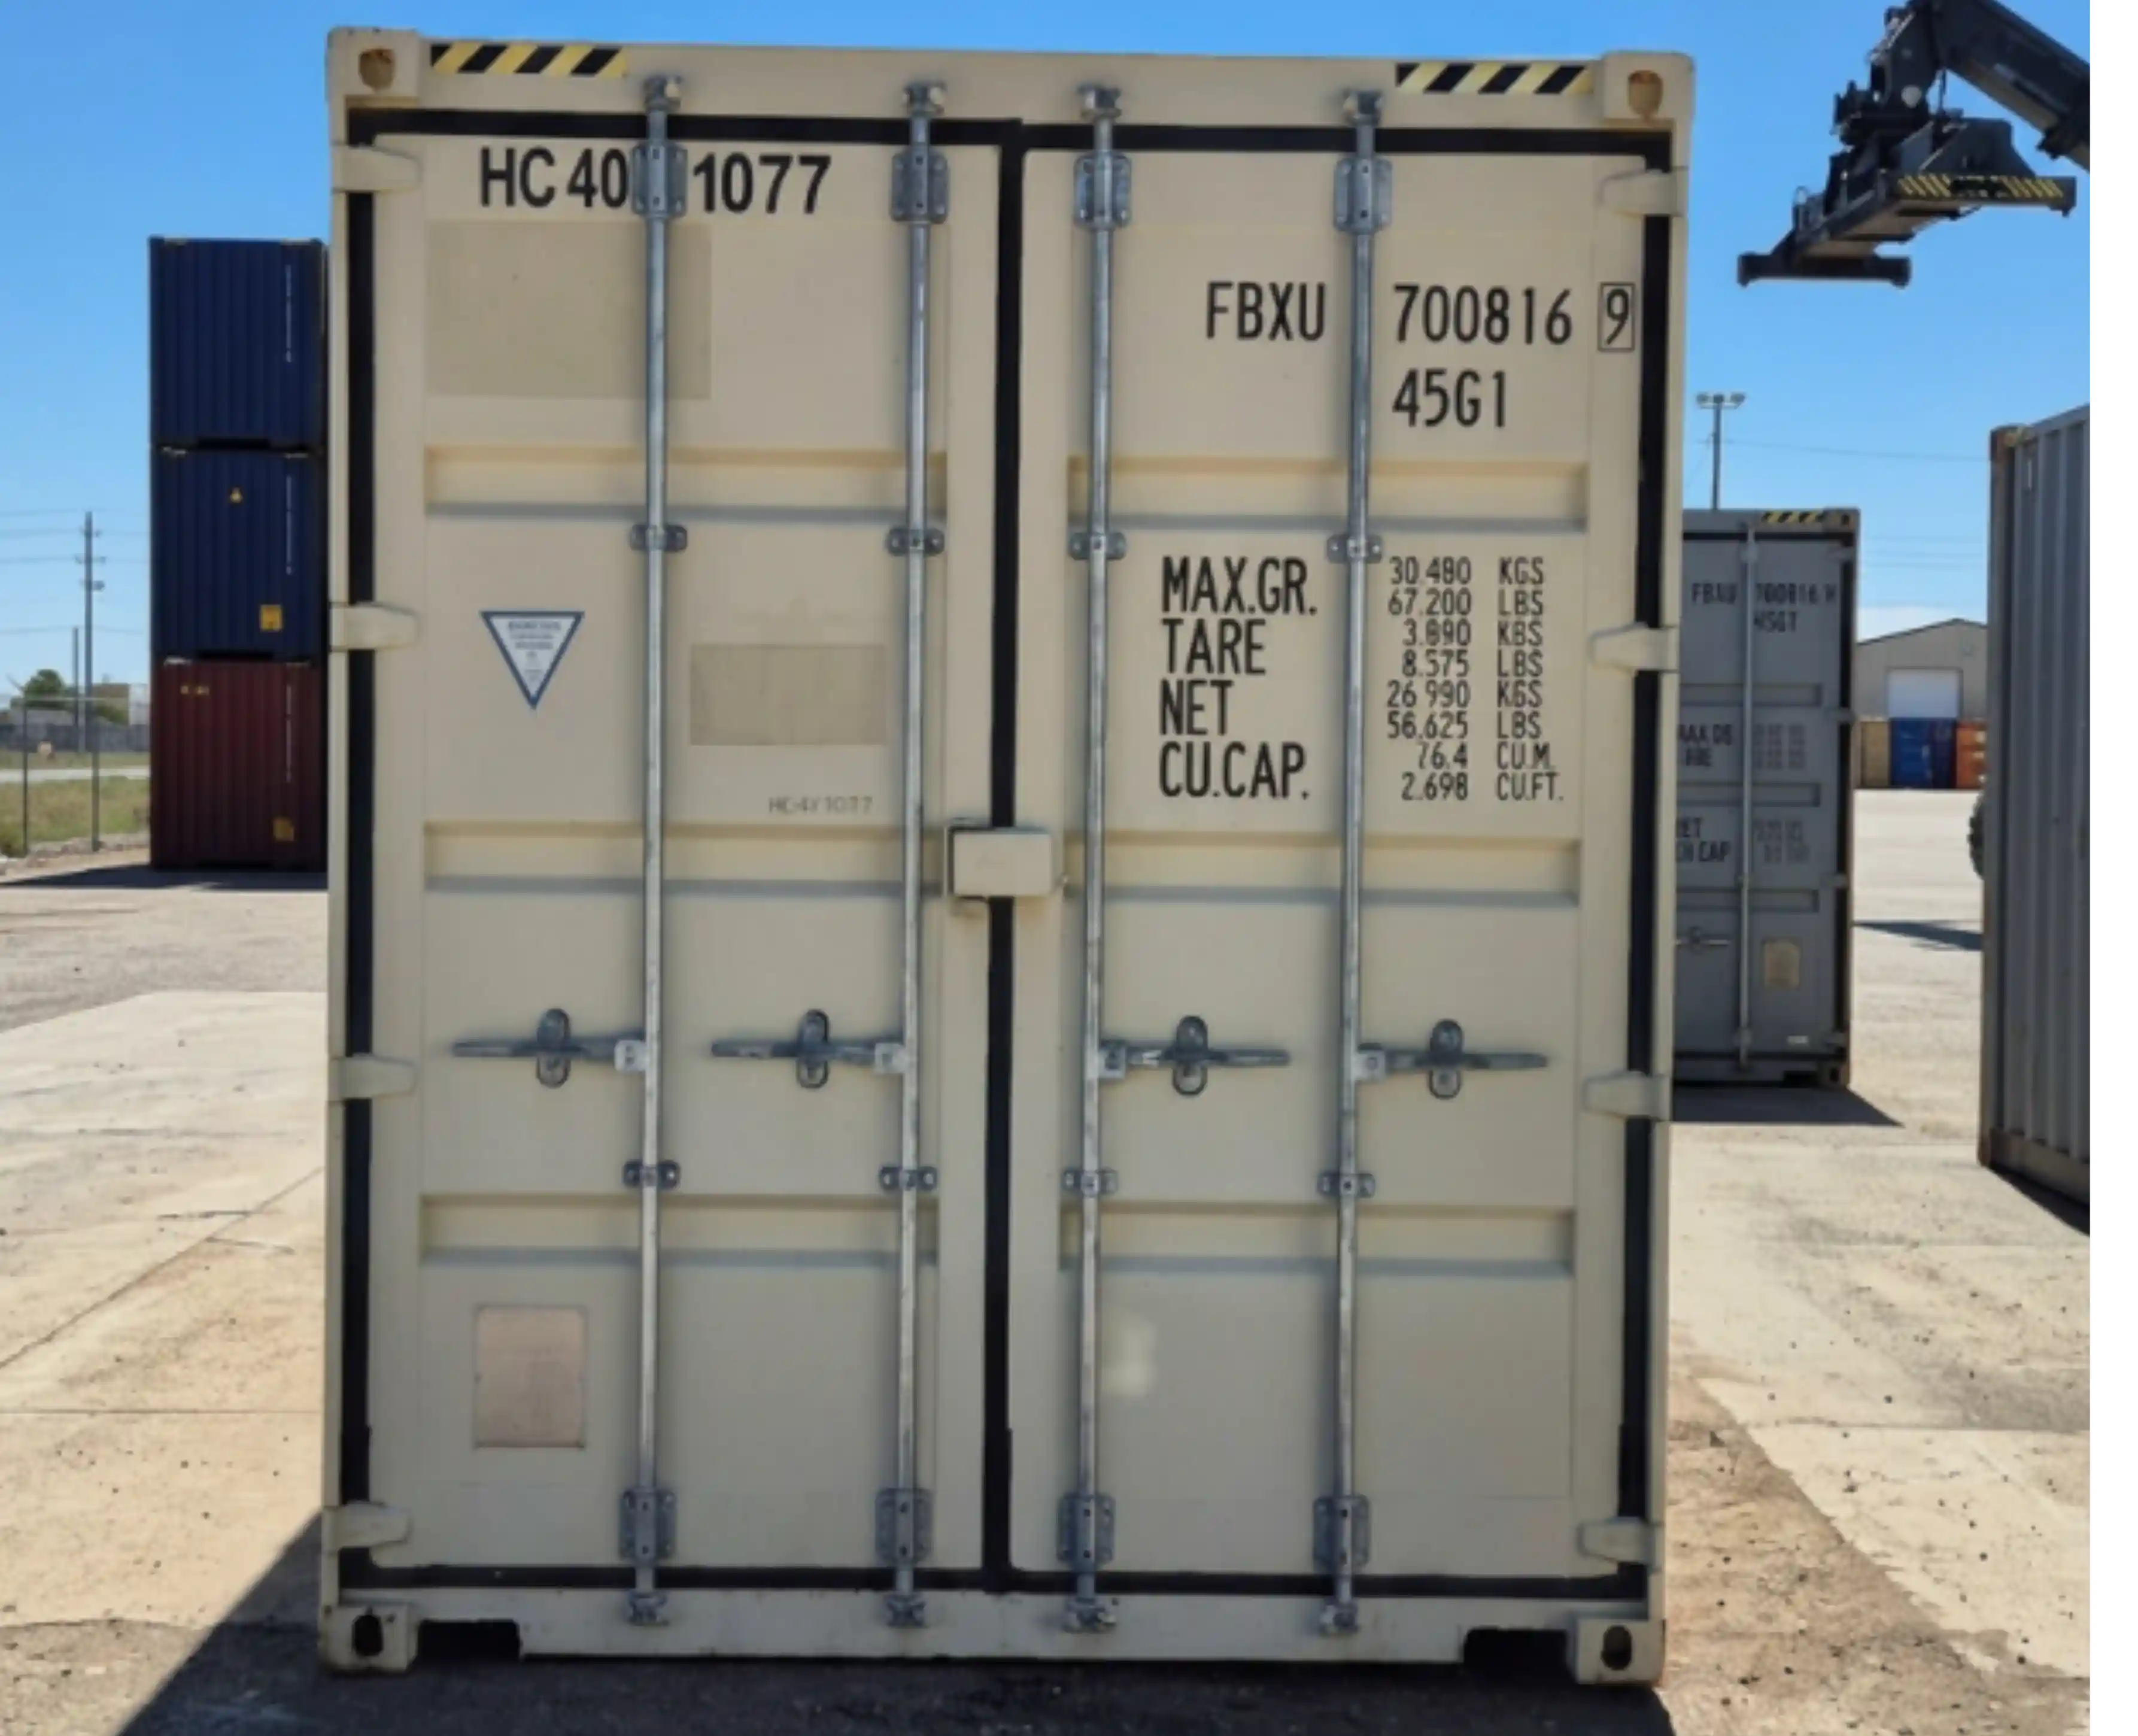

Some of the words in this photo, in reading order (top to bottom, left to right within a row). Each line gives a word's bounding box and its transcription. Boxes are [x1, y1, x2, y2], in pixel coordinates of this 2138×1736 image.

[479, 145, 557, 208] HC
[566, 147, 631, 210] 40
[691, 151, 832, 215] 1077
[1206, 281, 1328, 342] FBXU
[1393, 283, 1573, 345] 700816
[1604, 287, 1631, 345] 9
[1392, 368, 1506, 429] 45G1
[1161, 555, 1317, 616] MAX.GR.
[1499, 556, 1544, 587] KGS
[1498, 588, 1544, 617] LBS
[1160, 617, 1267, 676] TARE
[1402, 648, 1469, 678] 8.575
[1497, 648, 1543, 678] LBS
[1159, 678, 1235, 736] NET
[1497, 679, 1542, 708] KGS
[1497, 710, 1542, 740] LBS
[1159, 740, 1310, 800] CU.CAP.
